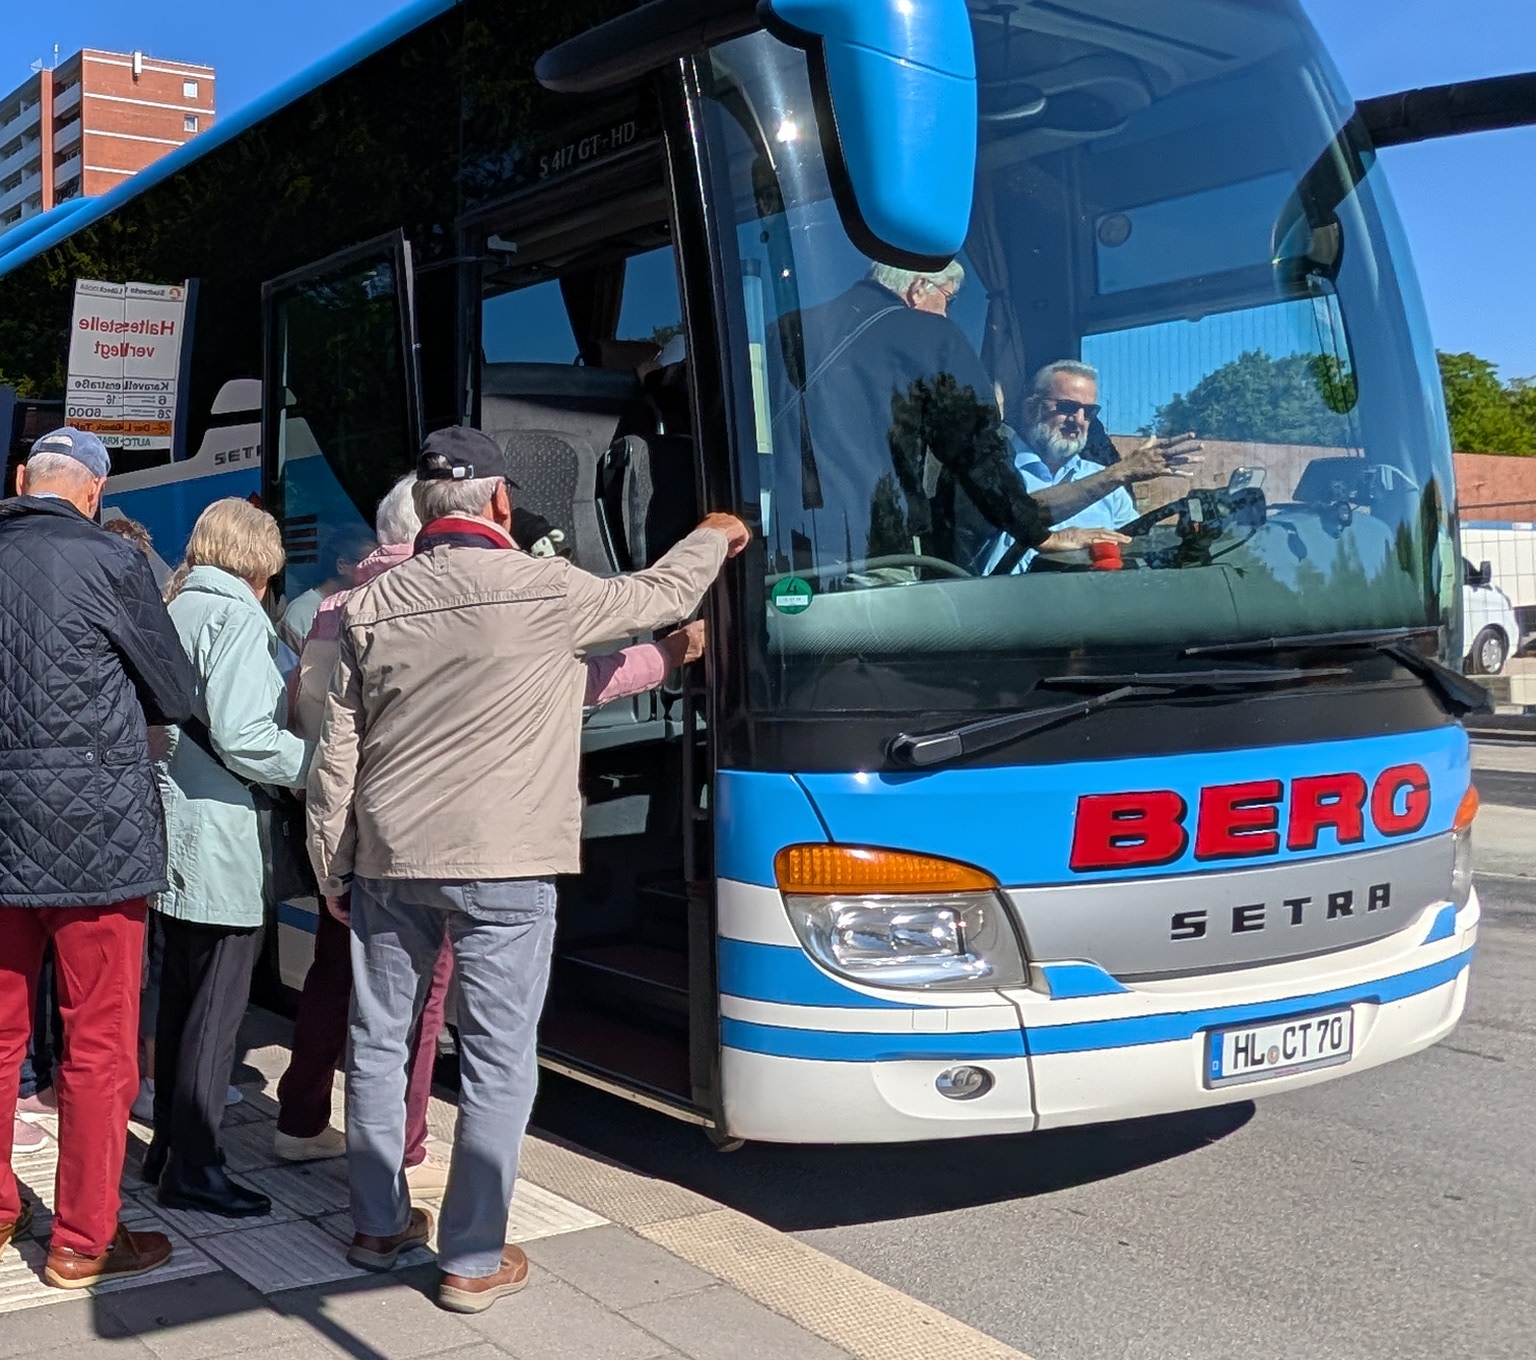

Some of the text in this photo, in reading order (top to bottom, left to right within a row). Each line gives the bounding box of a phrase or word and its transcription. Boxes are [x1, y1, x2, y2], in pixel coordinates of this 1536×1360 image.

[539, 155, 549, 177] S
[551, 144, 575, 171] 417
[1069, 762, 1431, 873] BERG
[1170, 882, 1391, 941] SETRA
[1233, 1032, 1265, 1069] HL
[1282, 1023, 1312, 1060] CT
[1317, 1016, 1342, 1053] 70
